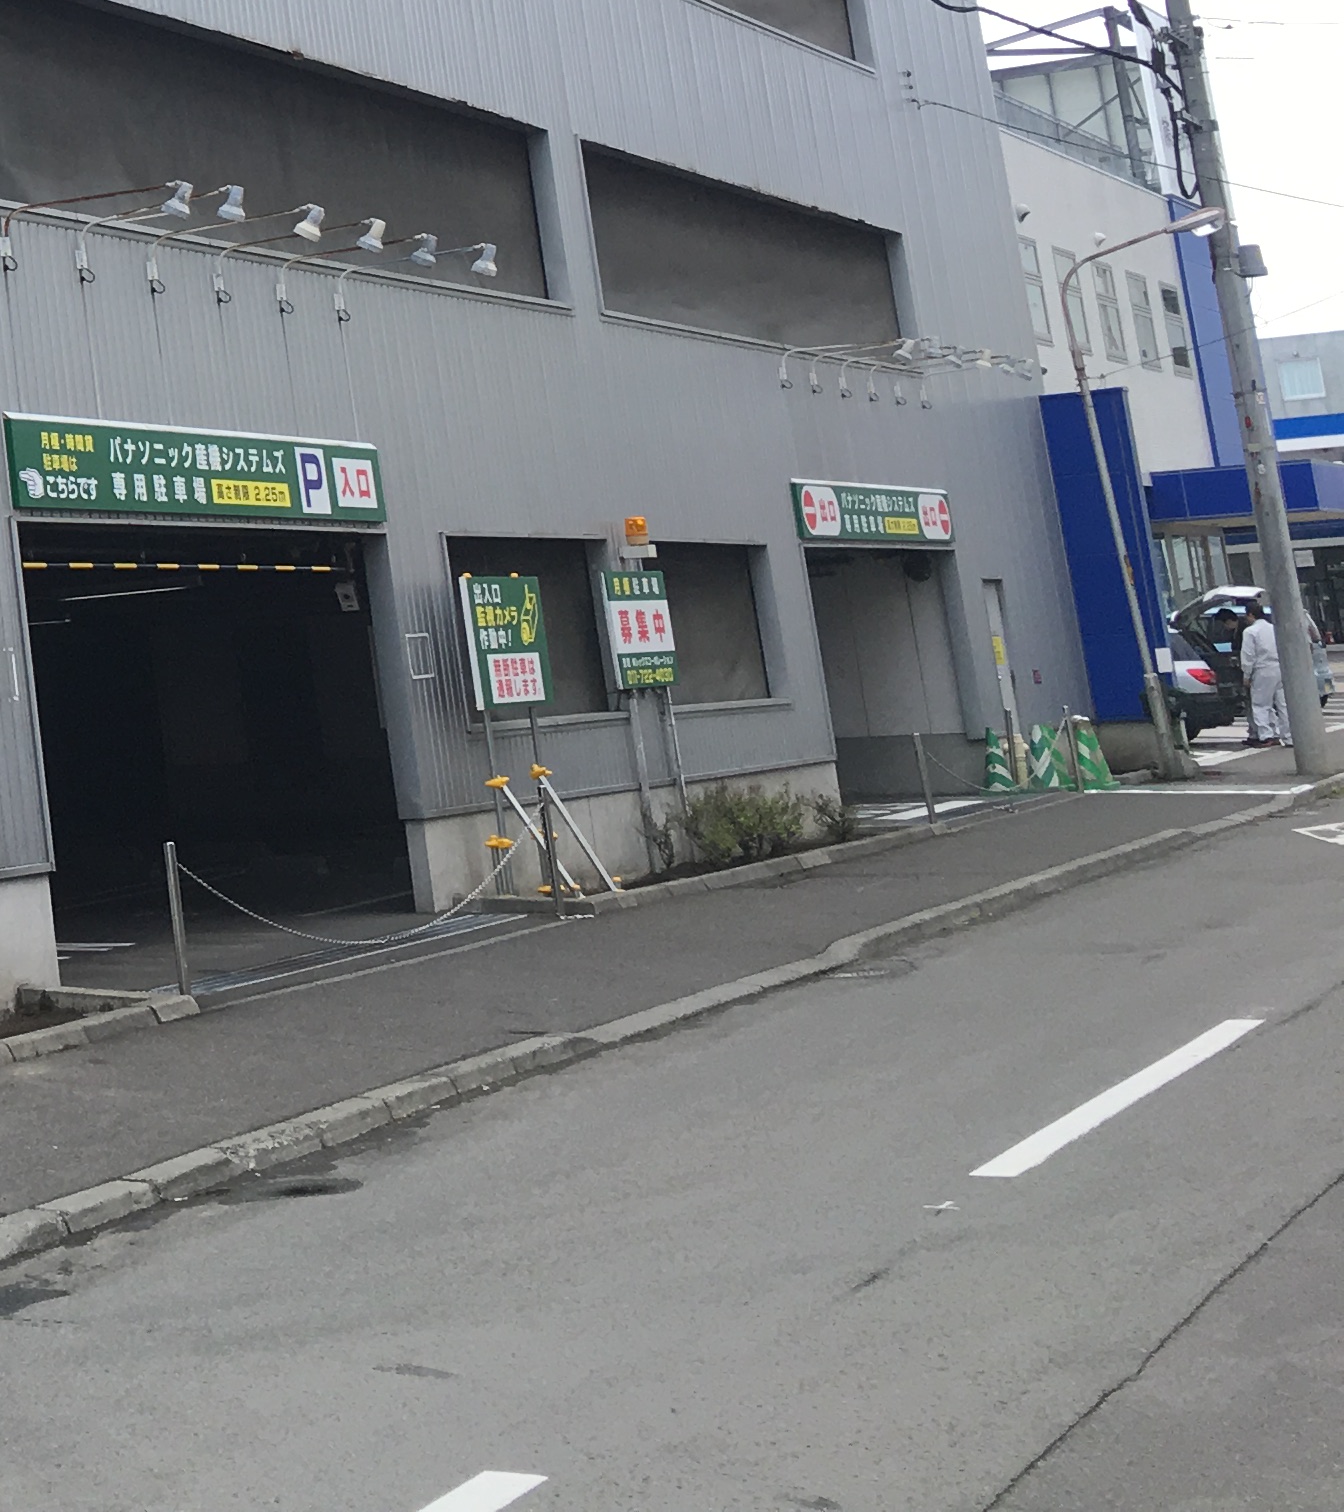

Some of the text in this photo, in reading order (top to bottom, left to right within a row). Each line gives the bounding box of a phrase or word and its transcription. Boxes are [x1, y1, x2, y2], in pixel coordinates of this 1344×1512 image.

[109, 436, 287, 476] パナソニック産機システムズ
[45, 474, 98, 501] こちらです
[111, 471, 207, 504] 専用駐車場
[253, 484, 287, 504] 2.25m
[300, 452, 324, 508] P
[340, 465, 370, 499] 入口
[473, 582, 502, 604] 出入口
[475, 605, 518, 626] 監視カメラ
[617, 609, 666, 645] 募集中
